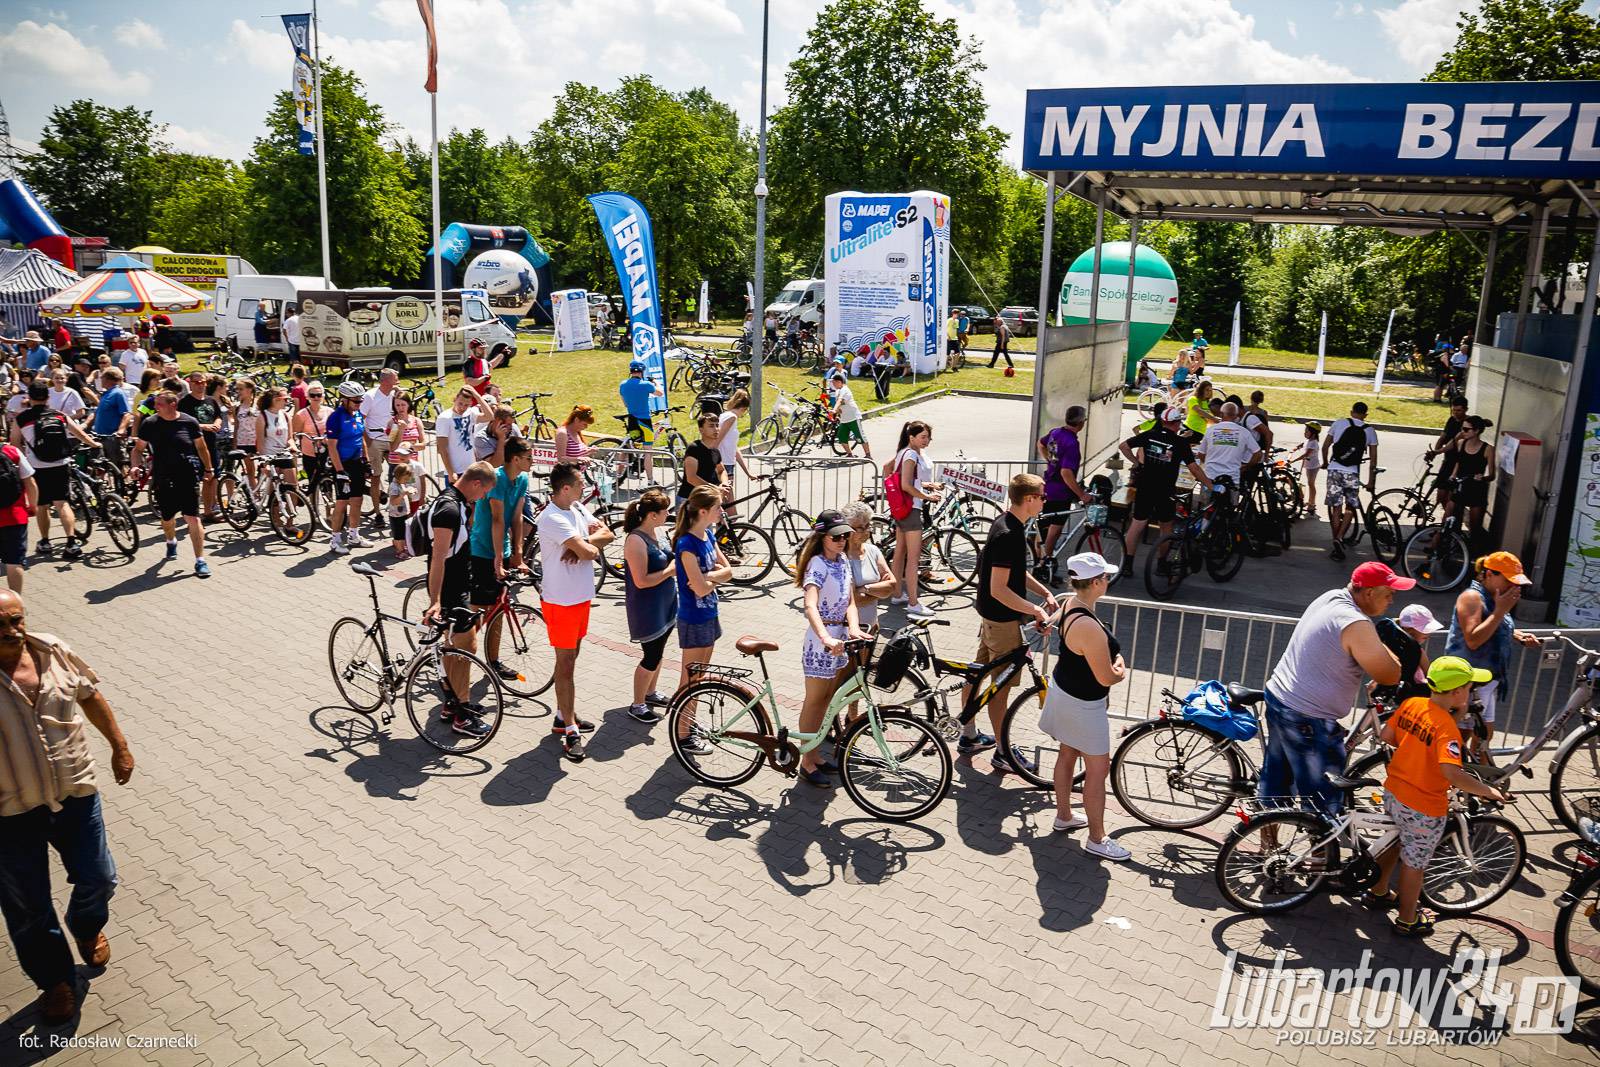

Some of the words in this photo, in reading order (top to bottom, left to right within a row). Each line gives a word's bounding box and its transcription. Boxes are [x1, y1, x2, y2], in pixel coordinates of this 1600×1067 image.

[1039, 103, 1326, 158] MYJNIA
[857, 204, 891, 217] MAPEI
[830, 217, 894, 264] Ultralite
[896, 205, 918, 229] S2
[155, 266, 185, 274] POMOC
[186, 267, 226, 275] DROGOWA
[612, 213, 652, 317] MAPEI
[924, 236, 933, 299] MAPEI
[910, 273, 920, 282] 20
[1073, 285, 1093, 296] Ban
[1100, 287, 1164, 305] Spółzielczy
[395, 309, 420, 318] KORAL
[389, 331, 409, 345] JAK
[412, 330, 457, 344] DAWEJ
[942, 467, 1003, 493] REJESTRACJA
